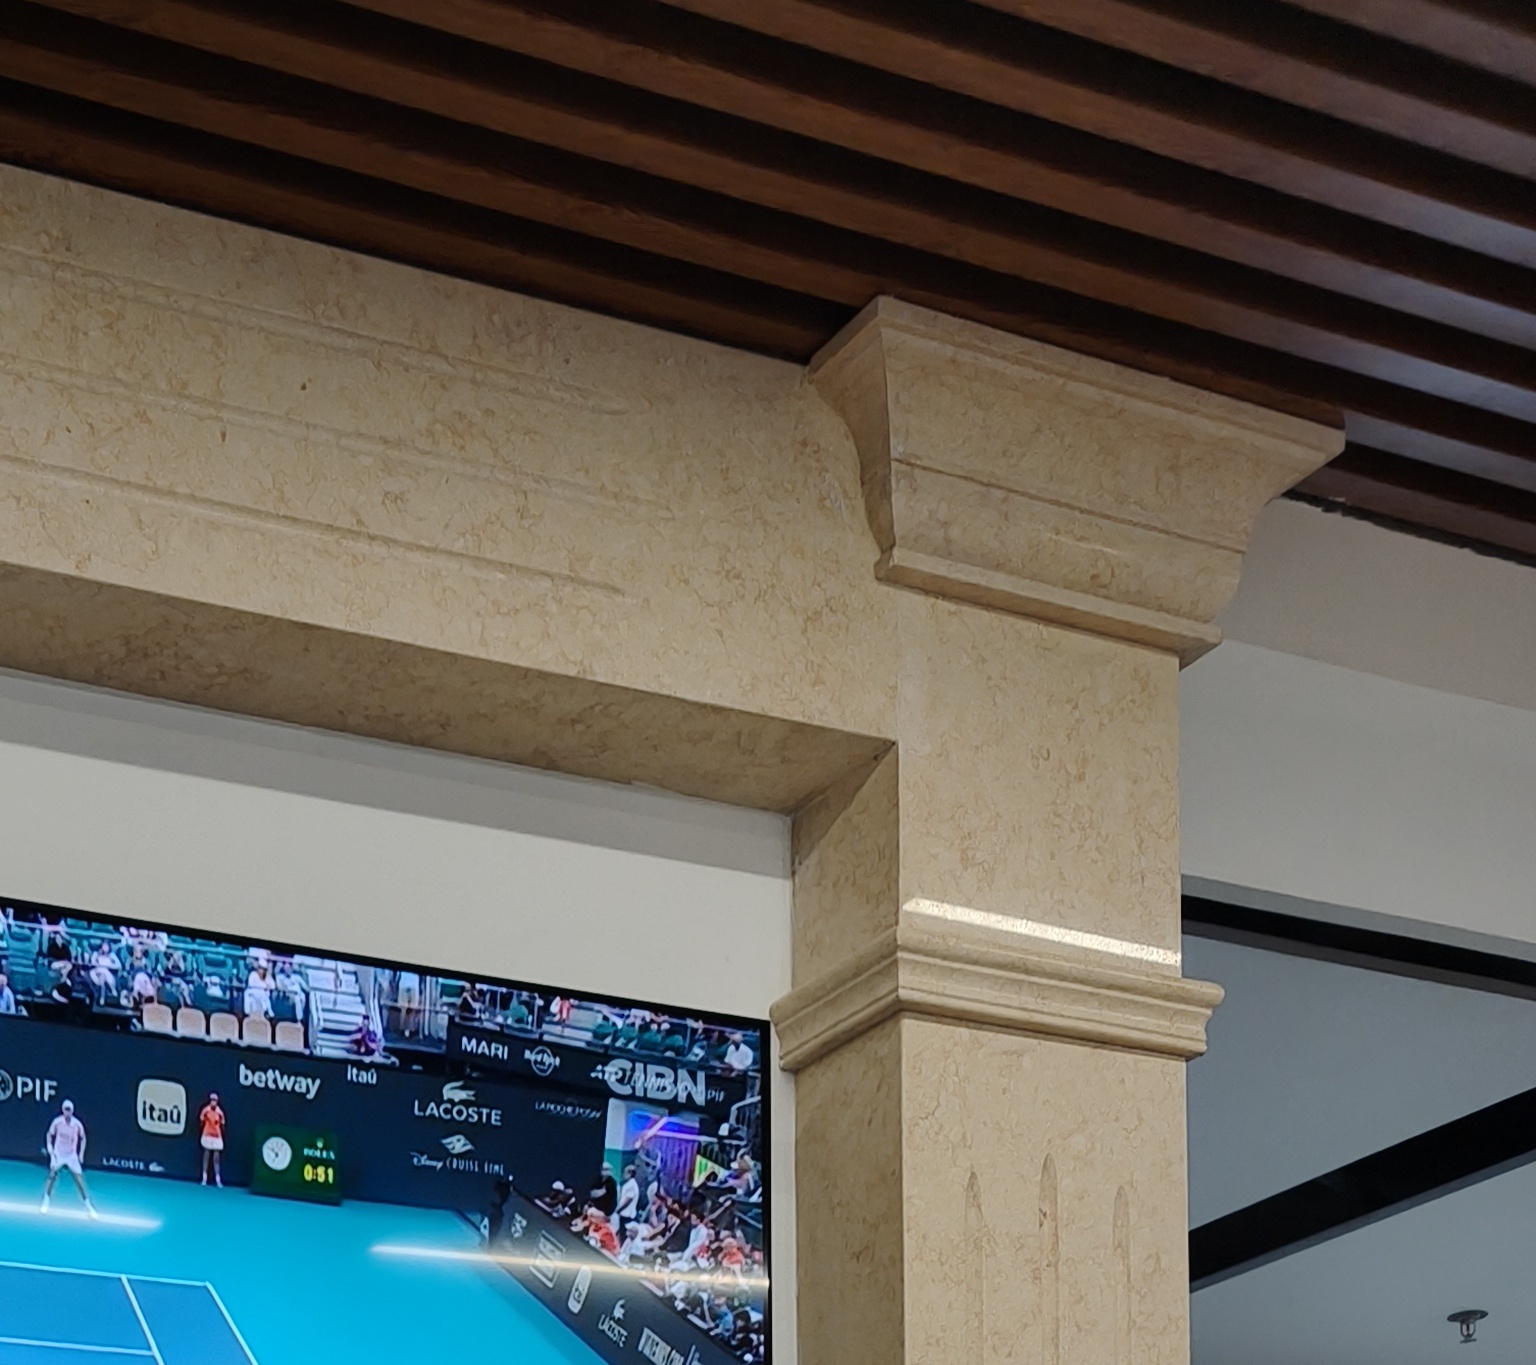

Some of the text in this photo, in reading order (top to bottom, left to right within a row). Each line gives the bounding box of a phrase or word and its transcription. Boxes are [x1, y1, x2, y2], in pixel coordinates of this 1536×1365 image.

[17, 1075, 58, 1103] PIF
[239, 1063, 321, 1100] betway
[605, 1058, 706, 1107] CIBN
[413, 1099, 502, 1127] LACOSTE
[303, 1162, 334, 1184] 0:51
